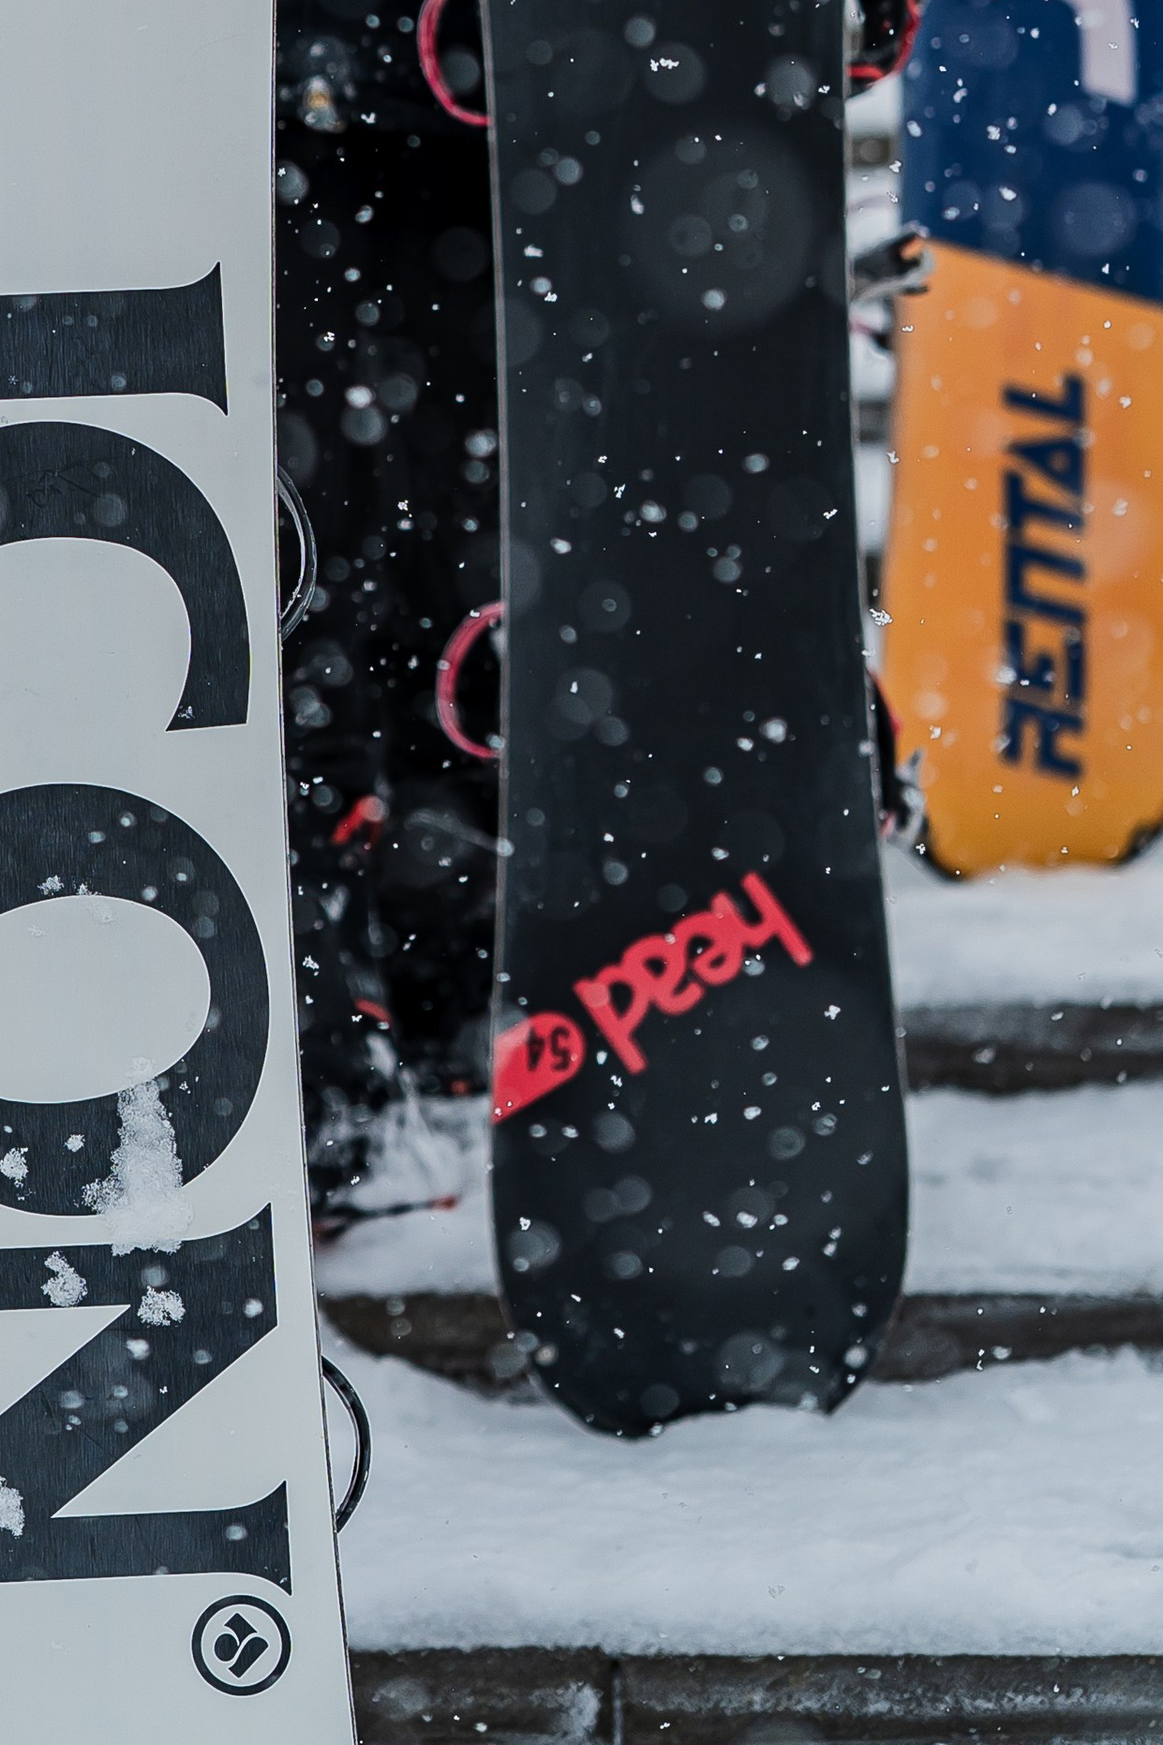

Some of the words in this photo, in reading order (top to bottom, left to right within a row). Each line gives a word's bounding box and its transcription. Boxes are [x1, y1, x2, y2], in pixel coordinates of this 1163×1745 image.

[1002, 368, 1087, 780] RENTAL
[526, 1025, 571, 1072] 54
[572, 870, 814, 1075] head
